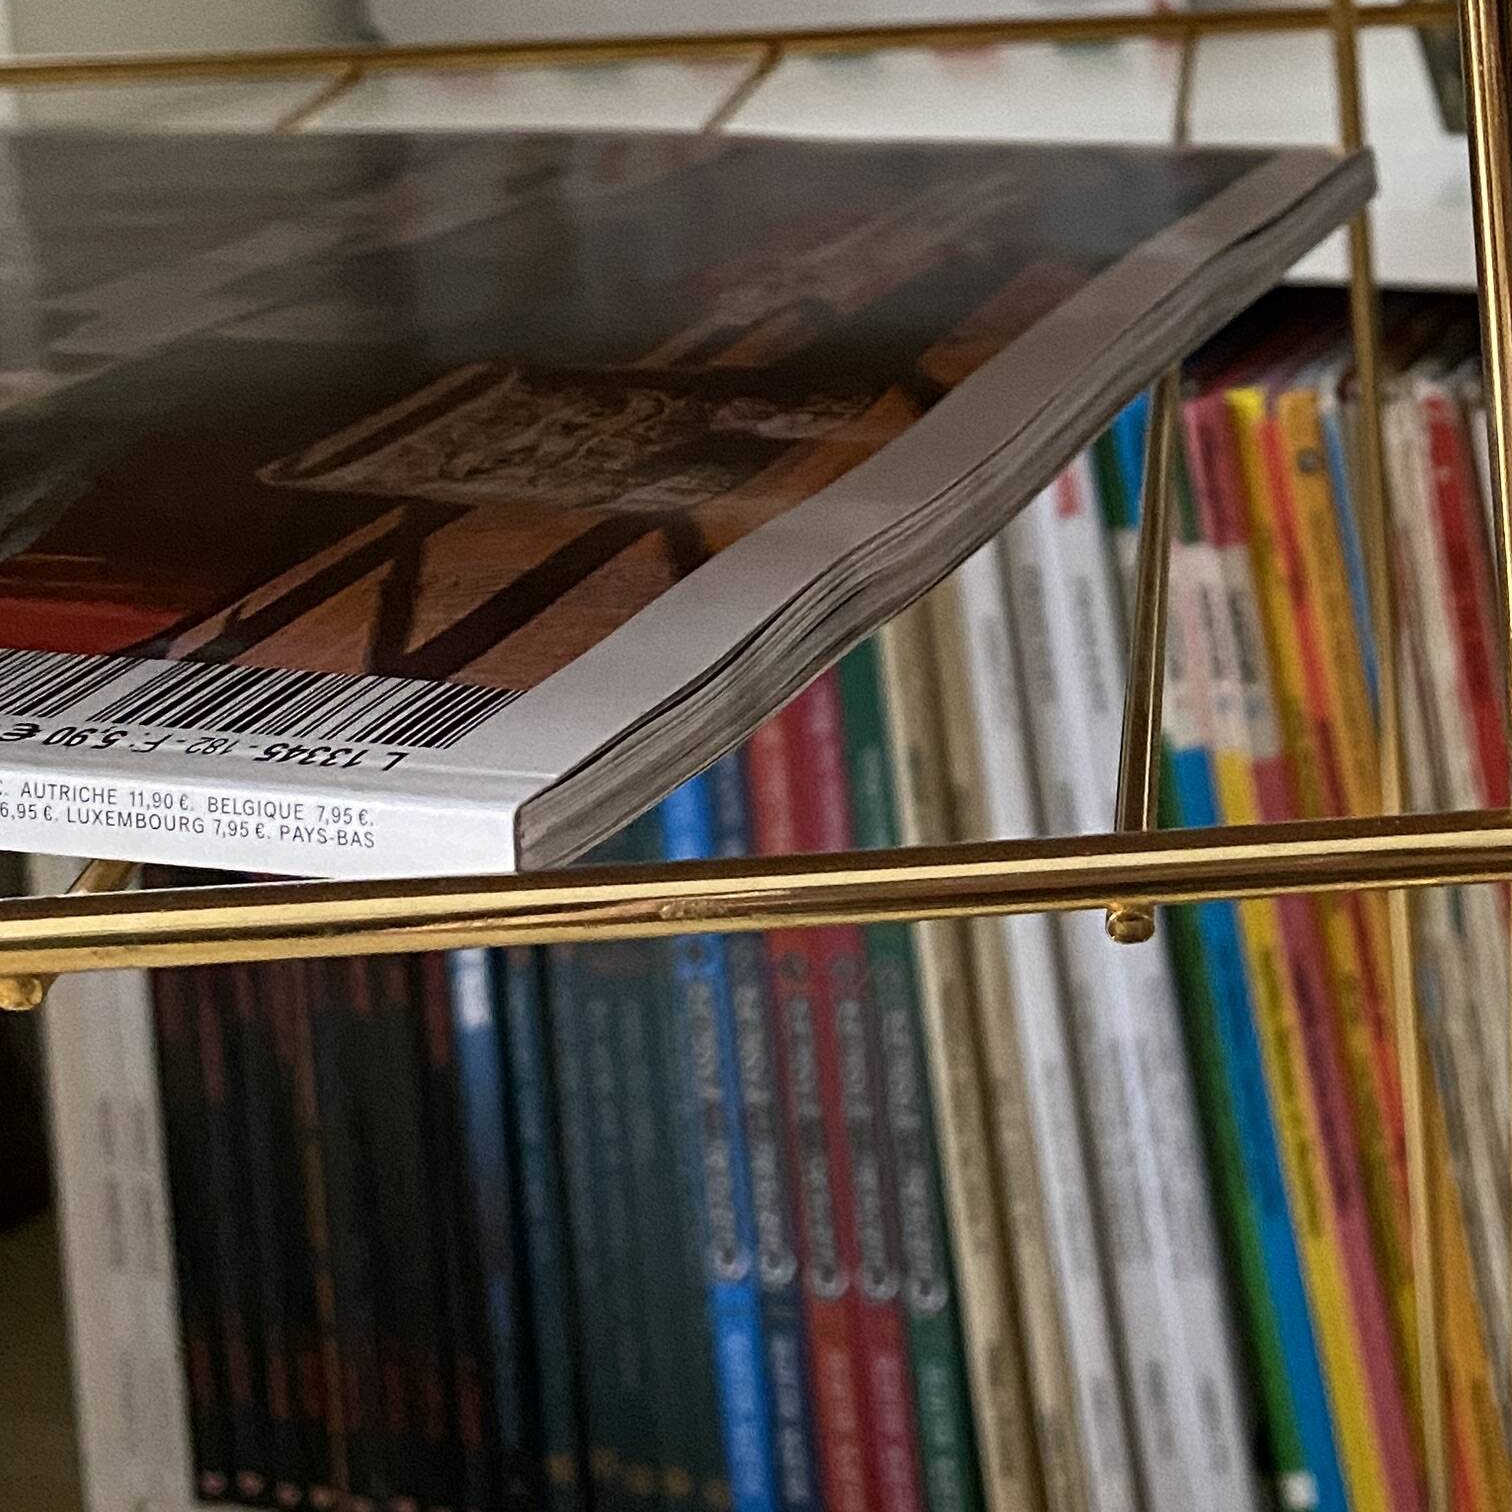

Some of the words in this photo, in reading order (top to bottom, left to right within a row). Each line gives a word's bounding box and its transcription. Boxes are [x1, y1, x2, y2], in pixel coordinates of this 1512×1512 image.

[42, 726, 128, 749] 5,90
[381, 752, 409, 771] L
[20, 781, 118, 806] AUTRICHE
[129, 790, 174, 811] 11,90
[207, 796, 305, 821] BELGIQUE
[316, 804, 353, 826] 7,95
[66, 805, 205, 834] LUXEMBOURG
[213, 817, 249, 839] 7,95
[279, 823, 375, 849] PAYS-BAS
